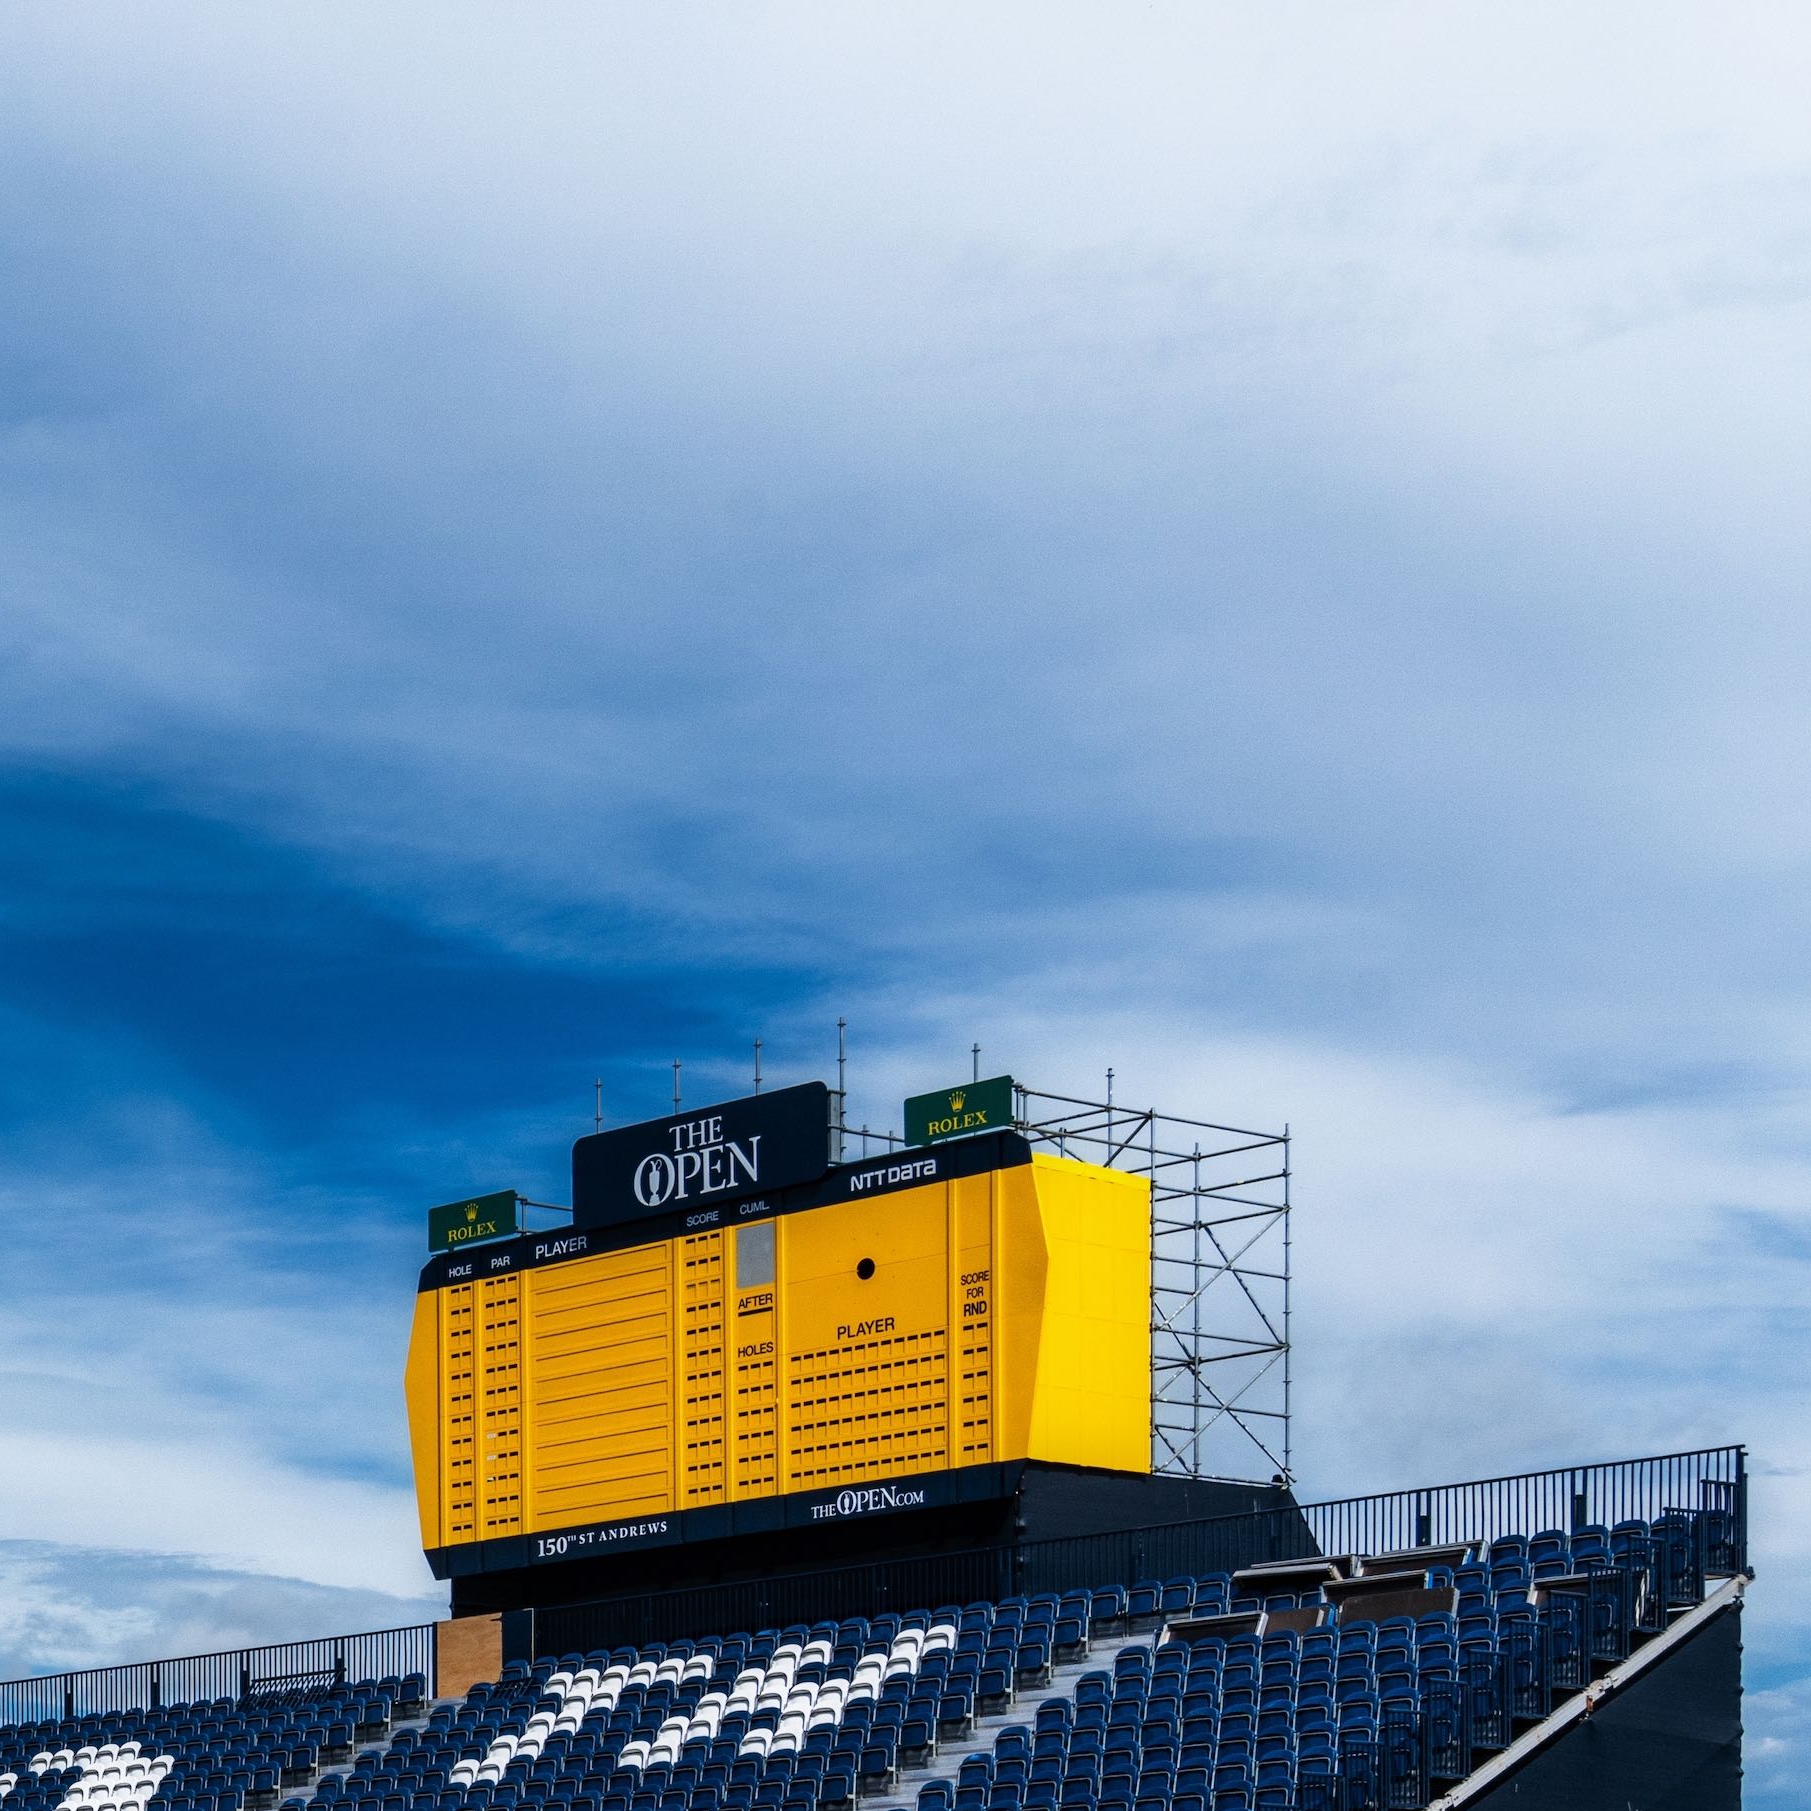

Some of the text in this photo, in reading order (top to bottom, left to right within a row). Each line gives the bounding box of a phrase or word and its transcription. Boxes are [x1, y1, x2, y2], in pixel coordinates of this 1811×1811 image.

[928, 1110, 987, 1136] ROLEX
[669, 1116, 723, 1152] THE
[634, 1135, 761, 1207] OPEN
[686, 1211, 719, 1227] SCORE
[447, 1221, 496, 1242] ROLEX
[535, 1236, 587, 1260] PLAYER
[491, 1255, 510, 1269] PAR
[448, 1264, 472, 1278] HOLE
[960, 1270, 989, 1286] SCORE
[738, 1293, 773, 1310] AFTER
[966, 1287, 984, 1299] FOR
[963, 1301, 987, 1317] RND
[837, 1317, 895, 1340] PLAYER
[738, 1342, 774, 1358] HOLES
[579, 1532, 595, 1544] ST
[599, 1521, 668, 1542] ANDREWS
